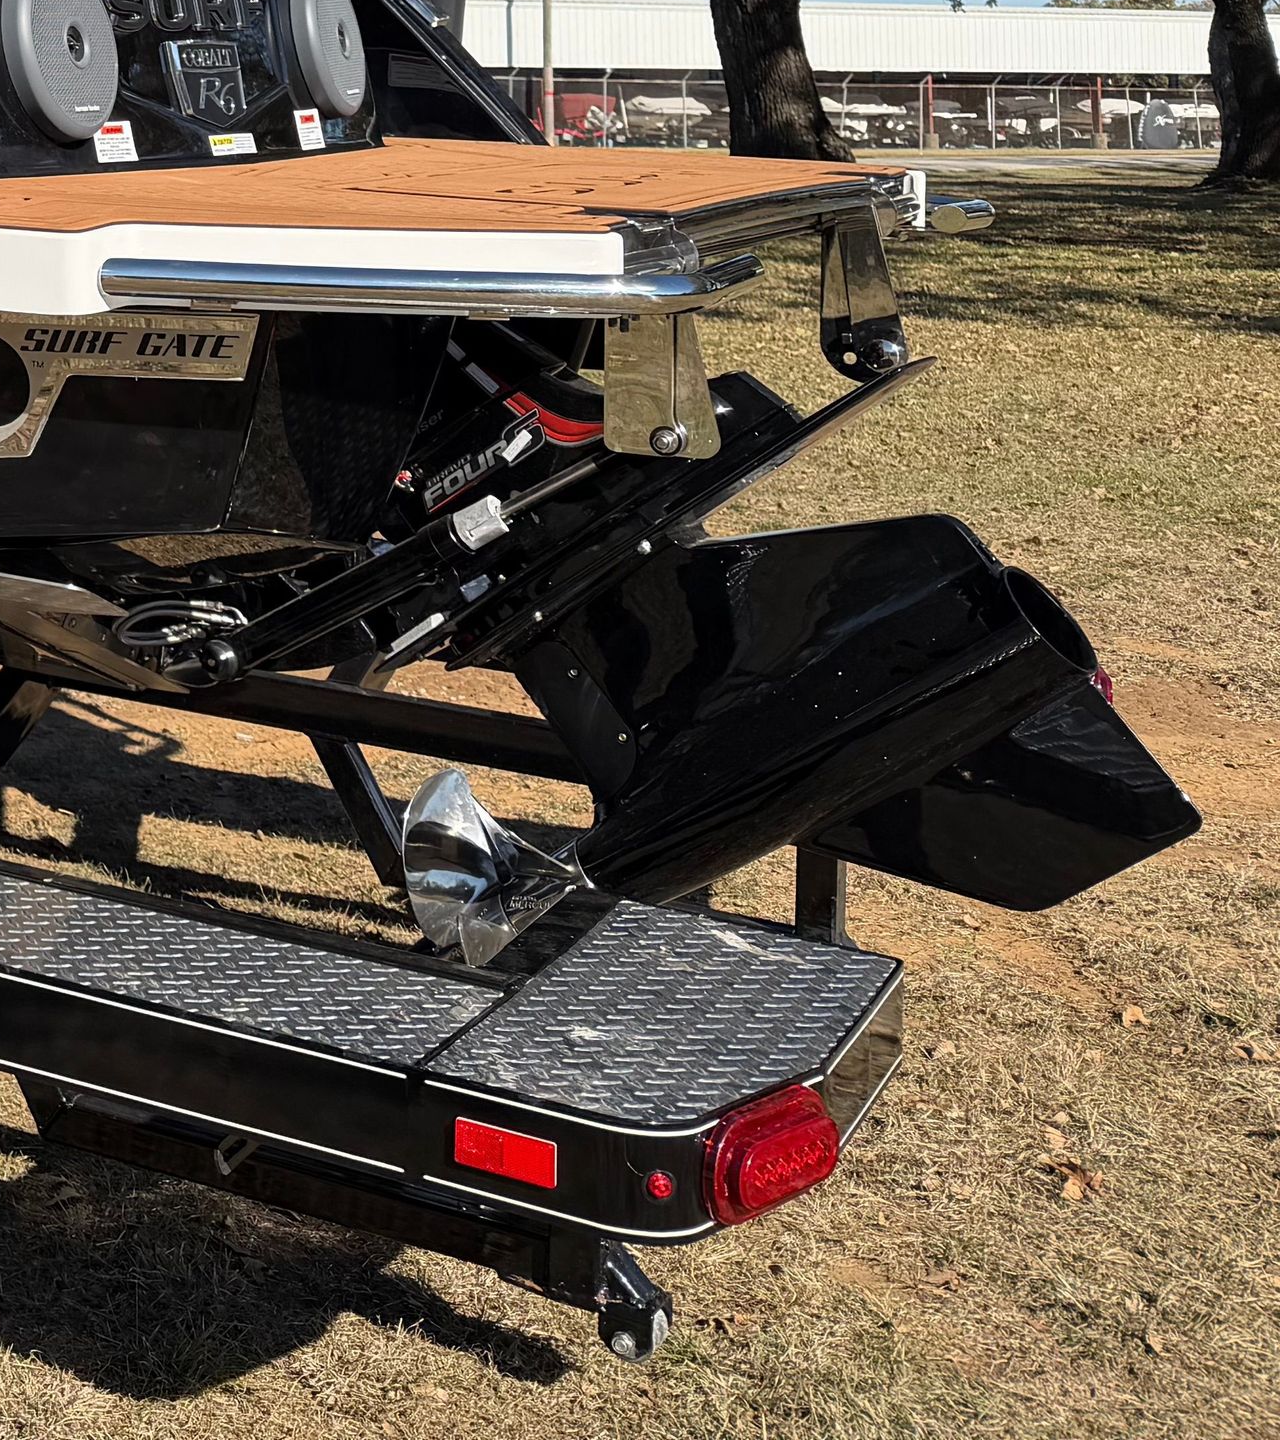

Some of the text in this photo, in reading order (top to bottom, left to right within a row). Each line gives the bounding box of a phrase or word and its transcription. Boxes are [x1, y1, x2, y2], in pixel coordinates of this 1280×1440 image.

[181, 48, 233, 68] COBALT
[198, 77, 235, 116] R6
[20, 328, 240, 359] SURF GATE
[424, 439, 508, 510] FOUR
